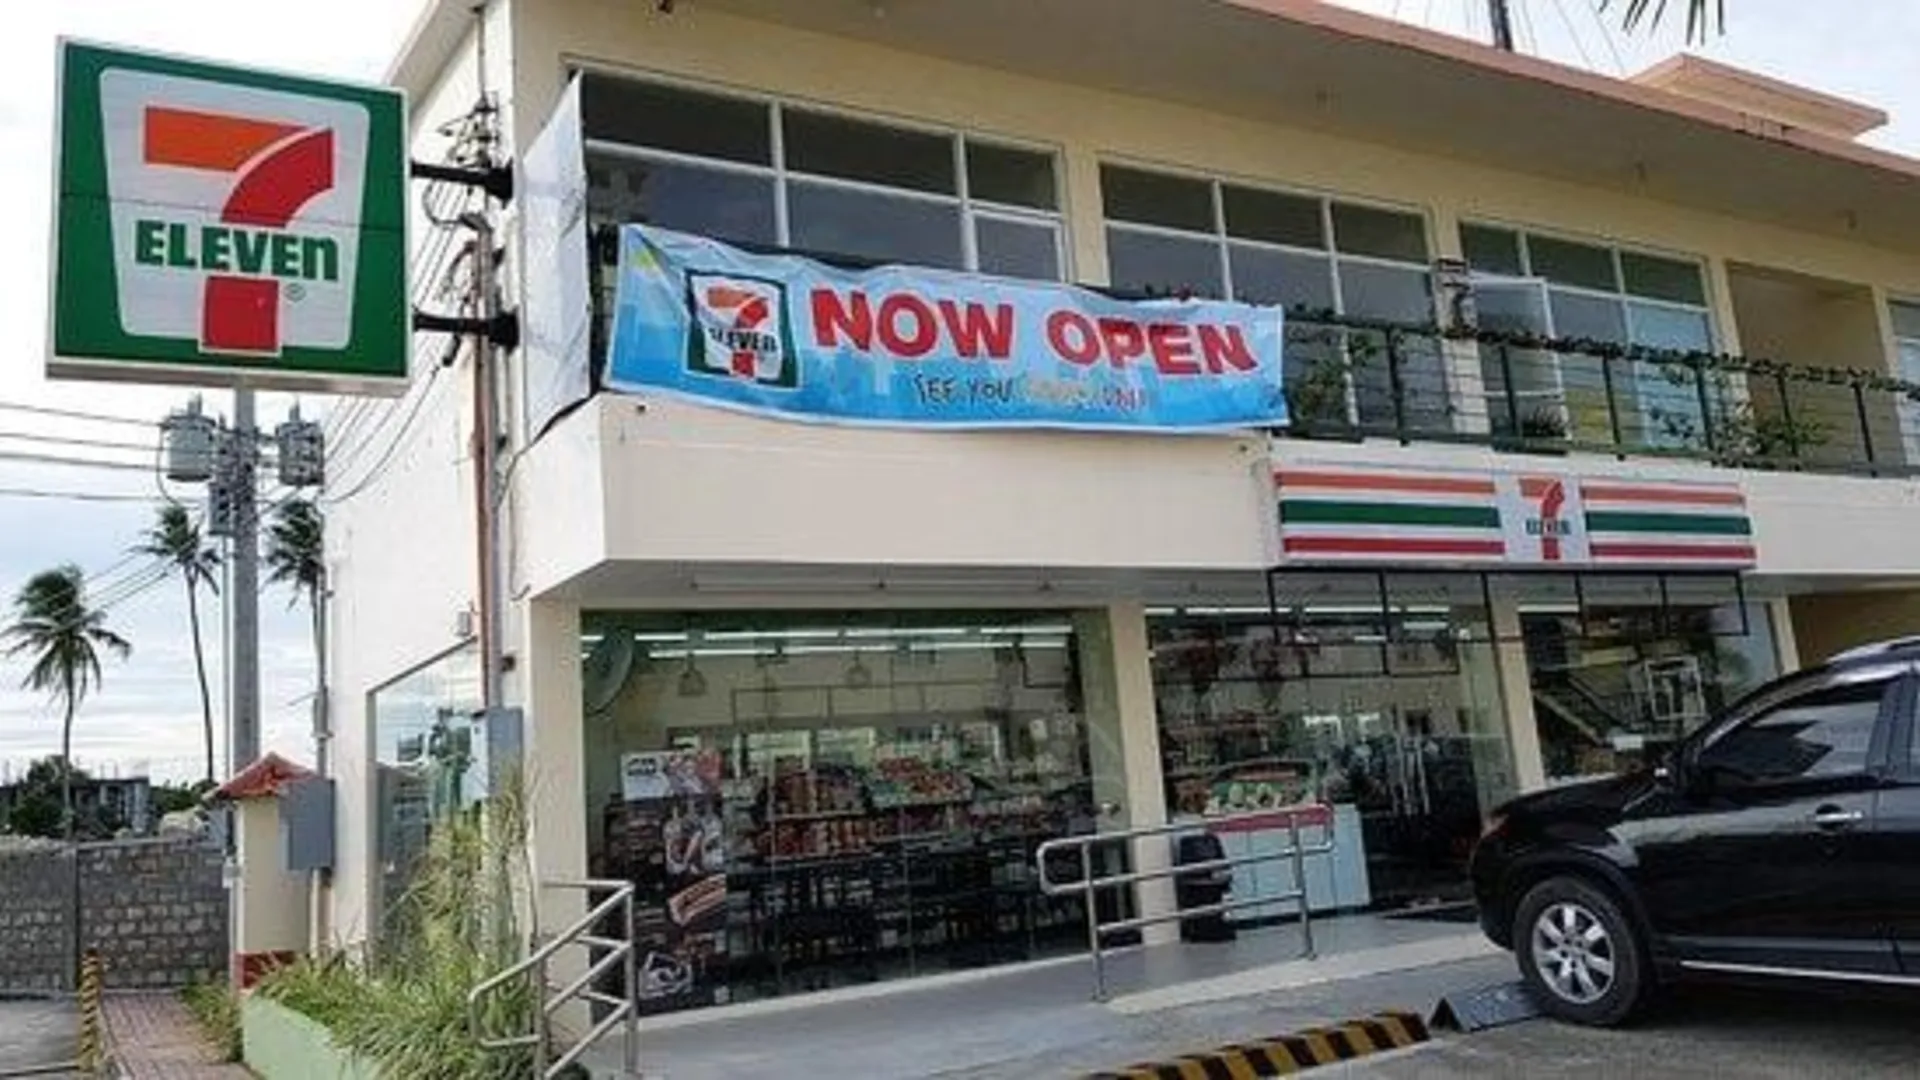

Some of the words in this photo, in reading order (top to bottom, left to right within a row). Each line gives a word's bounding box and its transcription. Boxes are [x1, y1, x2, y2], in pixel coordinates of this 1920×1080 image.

[144, 106, 334, 352] 7
[706, 286, 769, 377] 7
[811, 288, 1014, 359] NOW
[1046, 309, 1259, 376] OPEN
[968, 377, 1014, 406] YOU
[1518, 478, 1565, 560] 7
